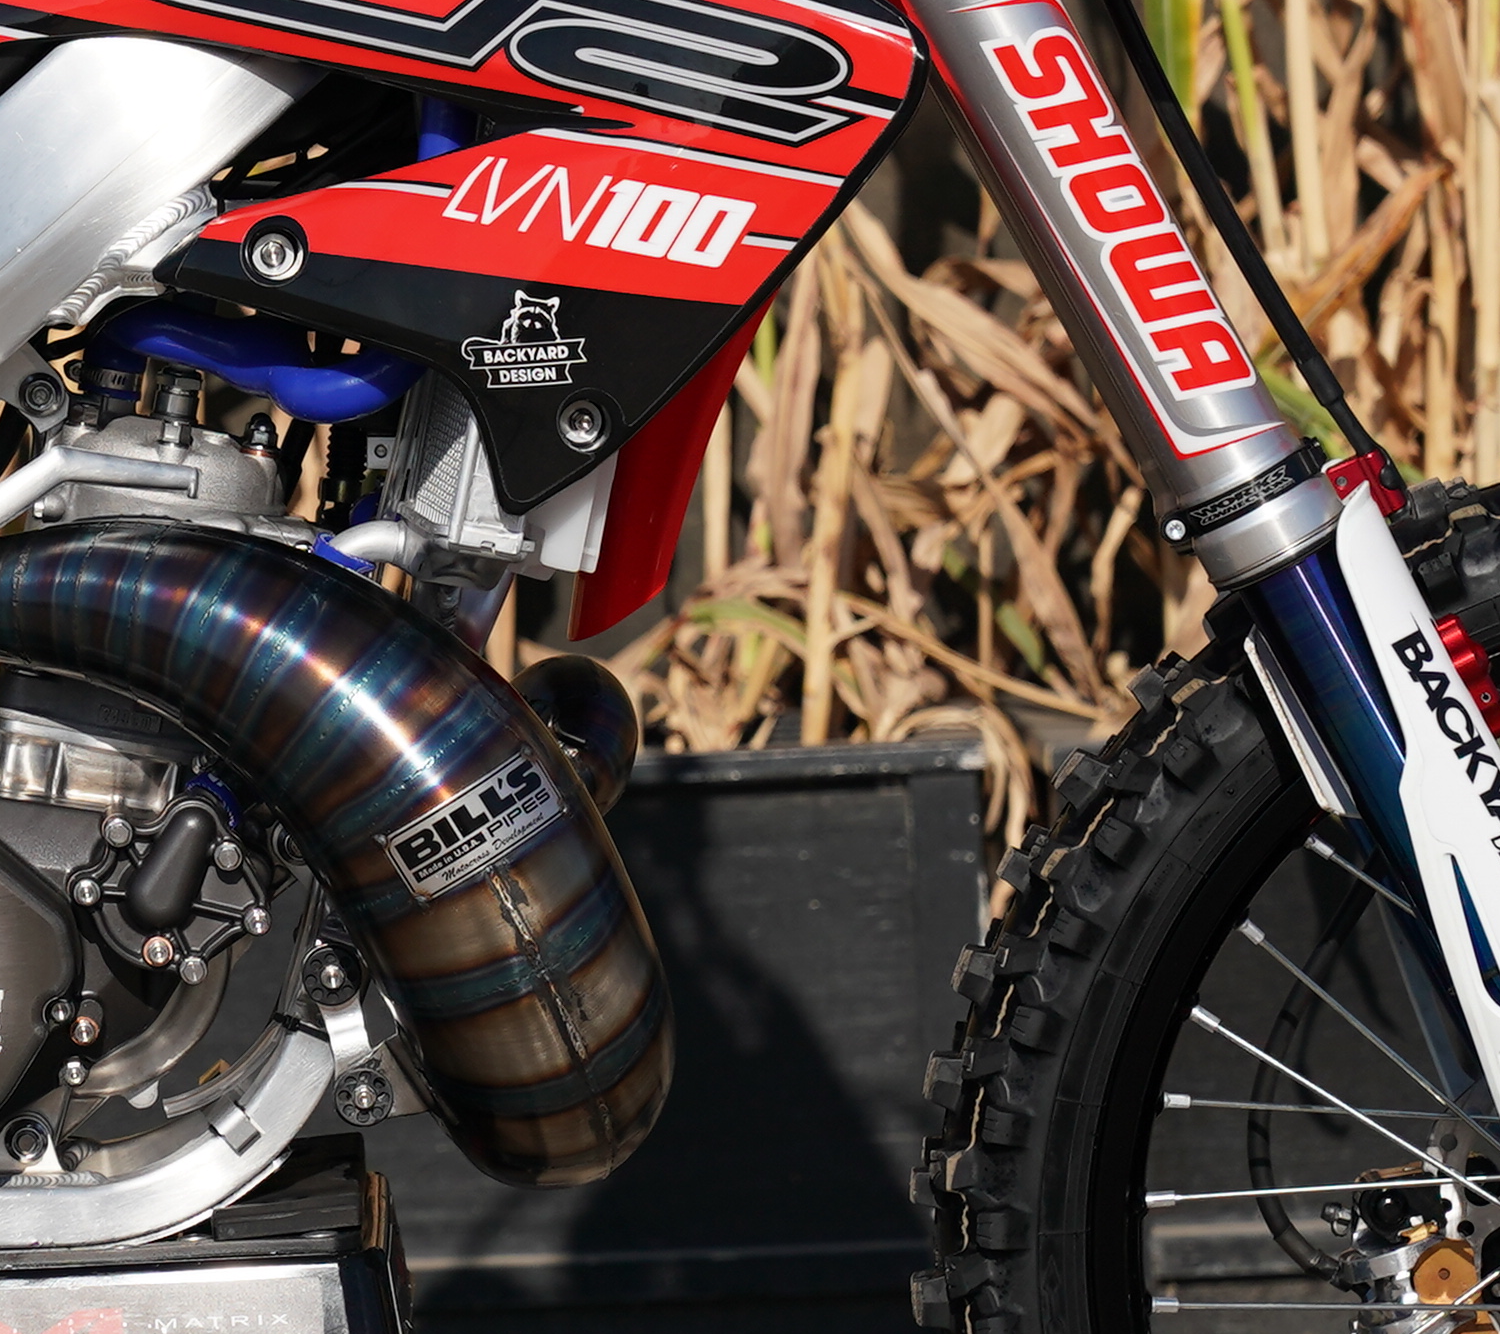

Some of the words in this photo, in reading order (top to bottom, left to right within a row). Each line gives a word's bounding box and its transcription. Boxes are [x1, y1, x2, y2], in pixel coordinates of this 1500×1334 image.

[992, 32, 1254, 393] SHOWA
[482, 345, 570, 365] BACKYARD
[499, 366, 557, 383] DESIGN
[1189, 465, 1287, 518] WORKS
[394, 759, 542, 871] BILL'S
[486, 787, 551, 838] PIPES
[491, 811, 545, 851] Development
[154, 1311, 289, 1331] MATRIX
